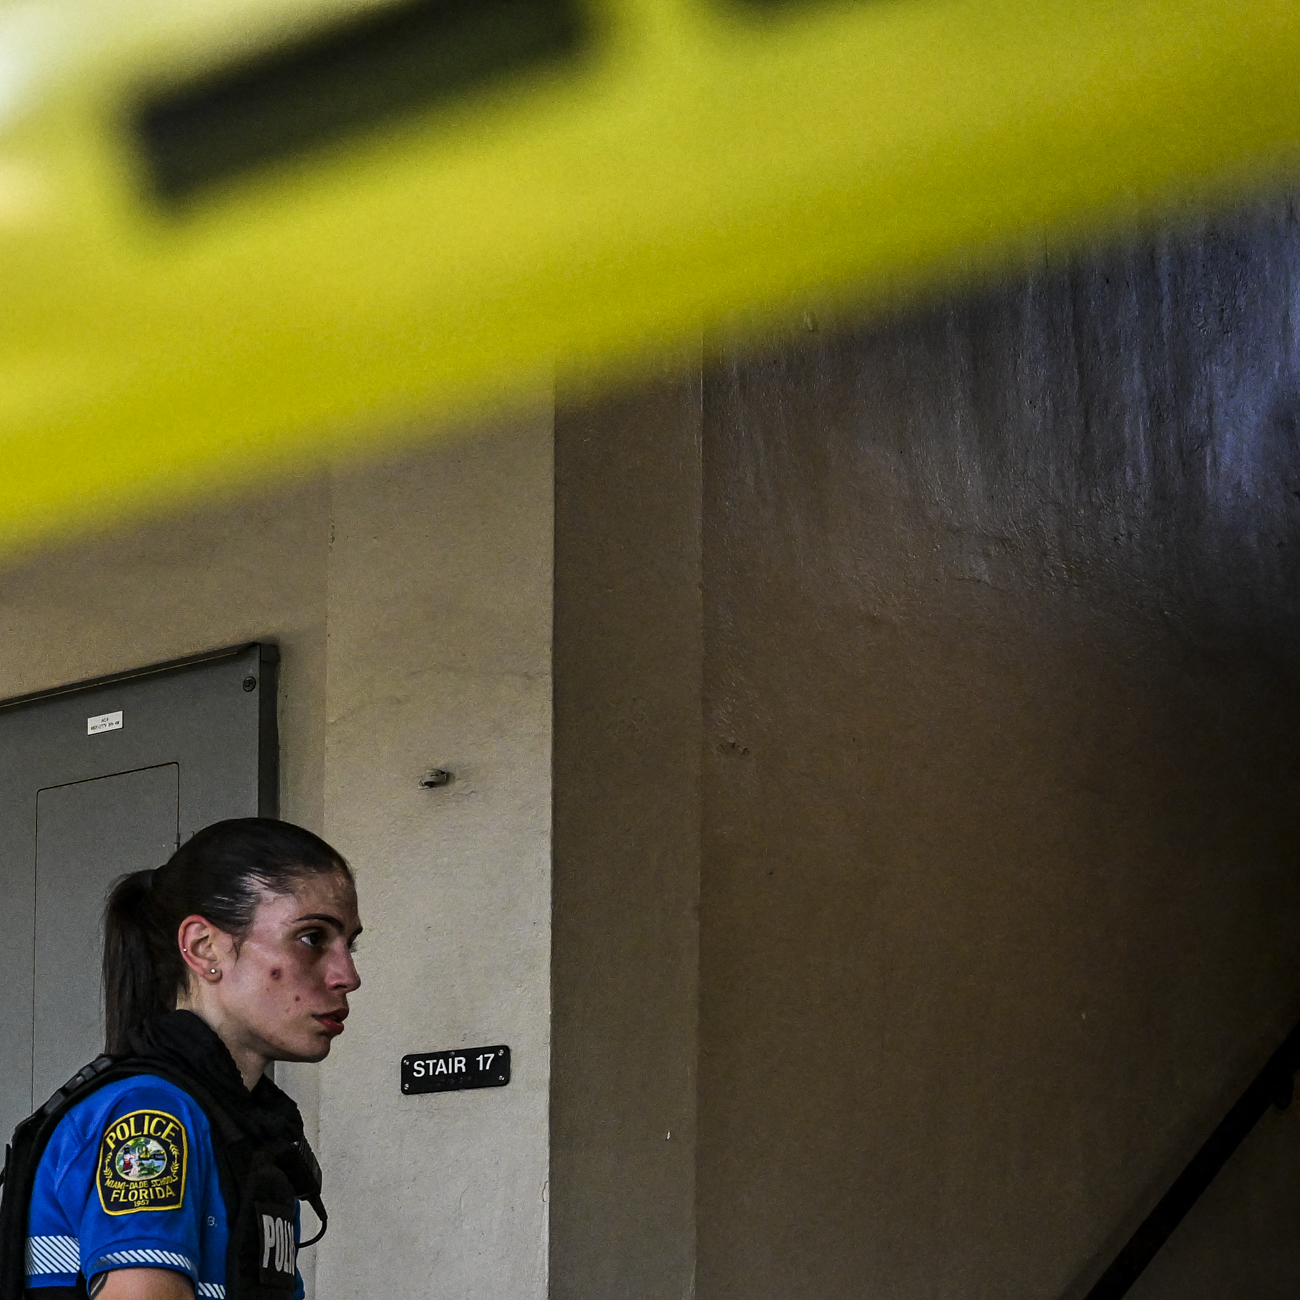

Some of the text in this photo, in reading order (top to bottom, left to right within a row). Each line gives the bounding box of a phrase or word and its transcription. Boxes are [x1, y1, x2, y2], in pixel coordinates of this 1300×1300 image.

[413, 1053, 495, 1078] STAIR 17
[106, 1115, 179, 1149] POLICE
[104, 1179, 149, 1190] MIAMI-DADE
[110, 1185, 176, 1202] FLORIDA
[262, 1214, 295, 1277] POLI
